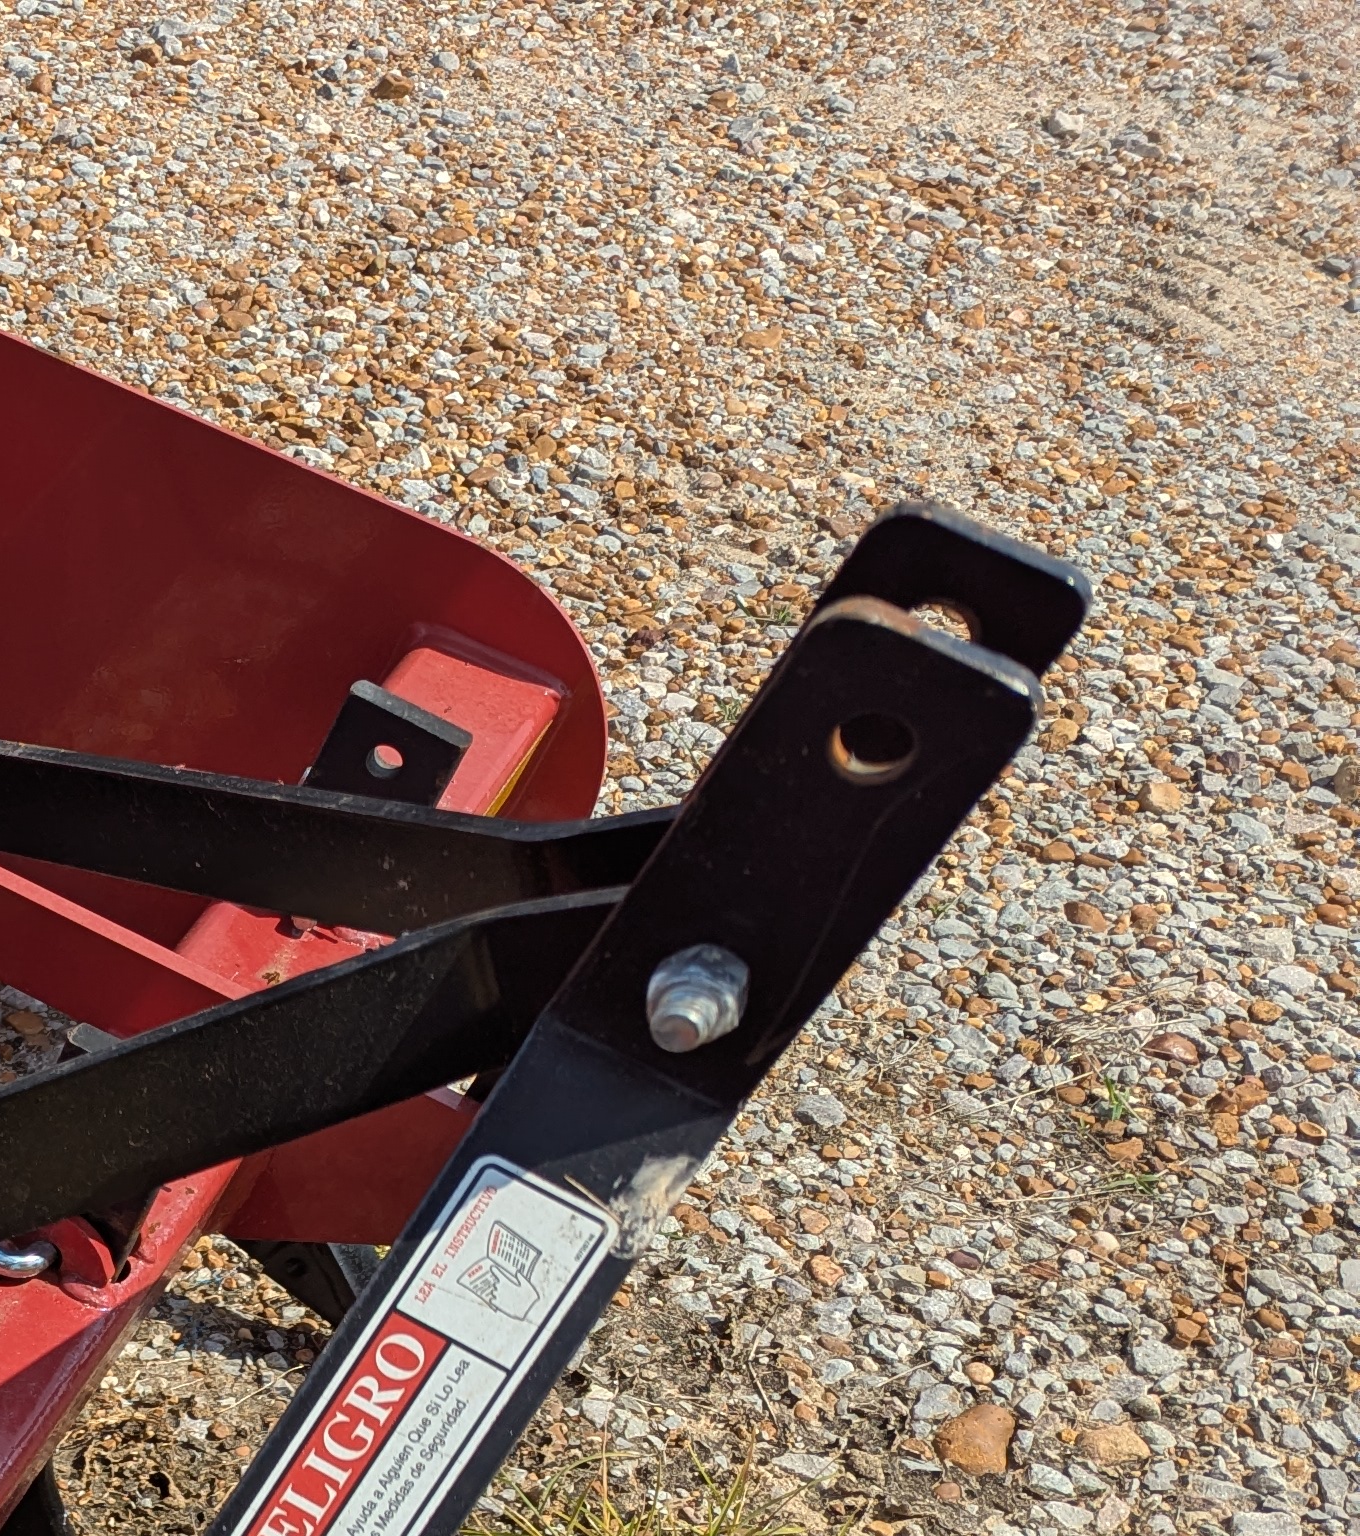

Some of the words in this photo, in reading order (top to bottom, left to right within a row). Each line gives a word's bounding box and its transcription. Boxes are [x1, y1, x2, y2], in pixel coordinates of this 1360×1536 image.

[414, 1279, 436, 1303] LEA
[431, 1262, 448, 1279] EL
[444, 1185, 498, 1258] INSTRUCTIVO
[446, 1359, 471, 1385] Lea
[434, 1384, 454, 1403] Lo
[425, 1399, 442, 1417] Si
[407, 1417, 432, 1444] Que
[373, 1478, 415, 1532] Medidas
[410, 1461, 426, 1480] de
[419, 1397, 470, 1462] Seguridad.
[378, 1444, 414, 1492] Alguien
[373, 1489, 385, 1501] a
